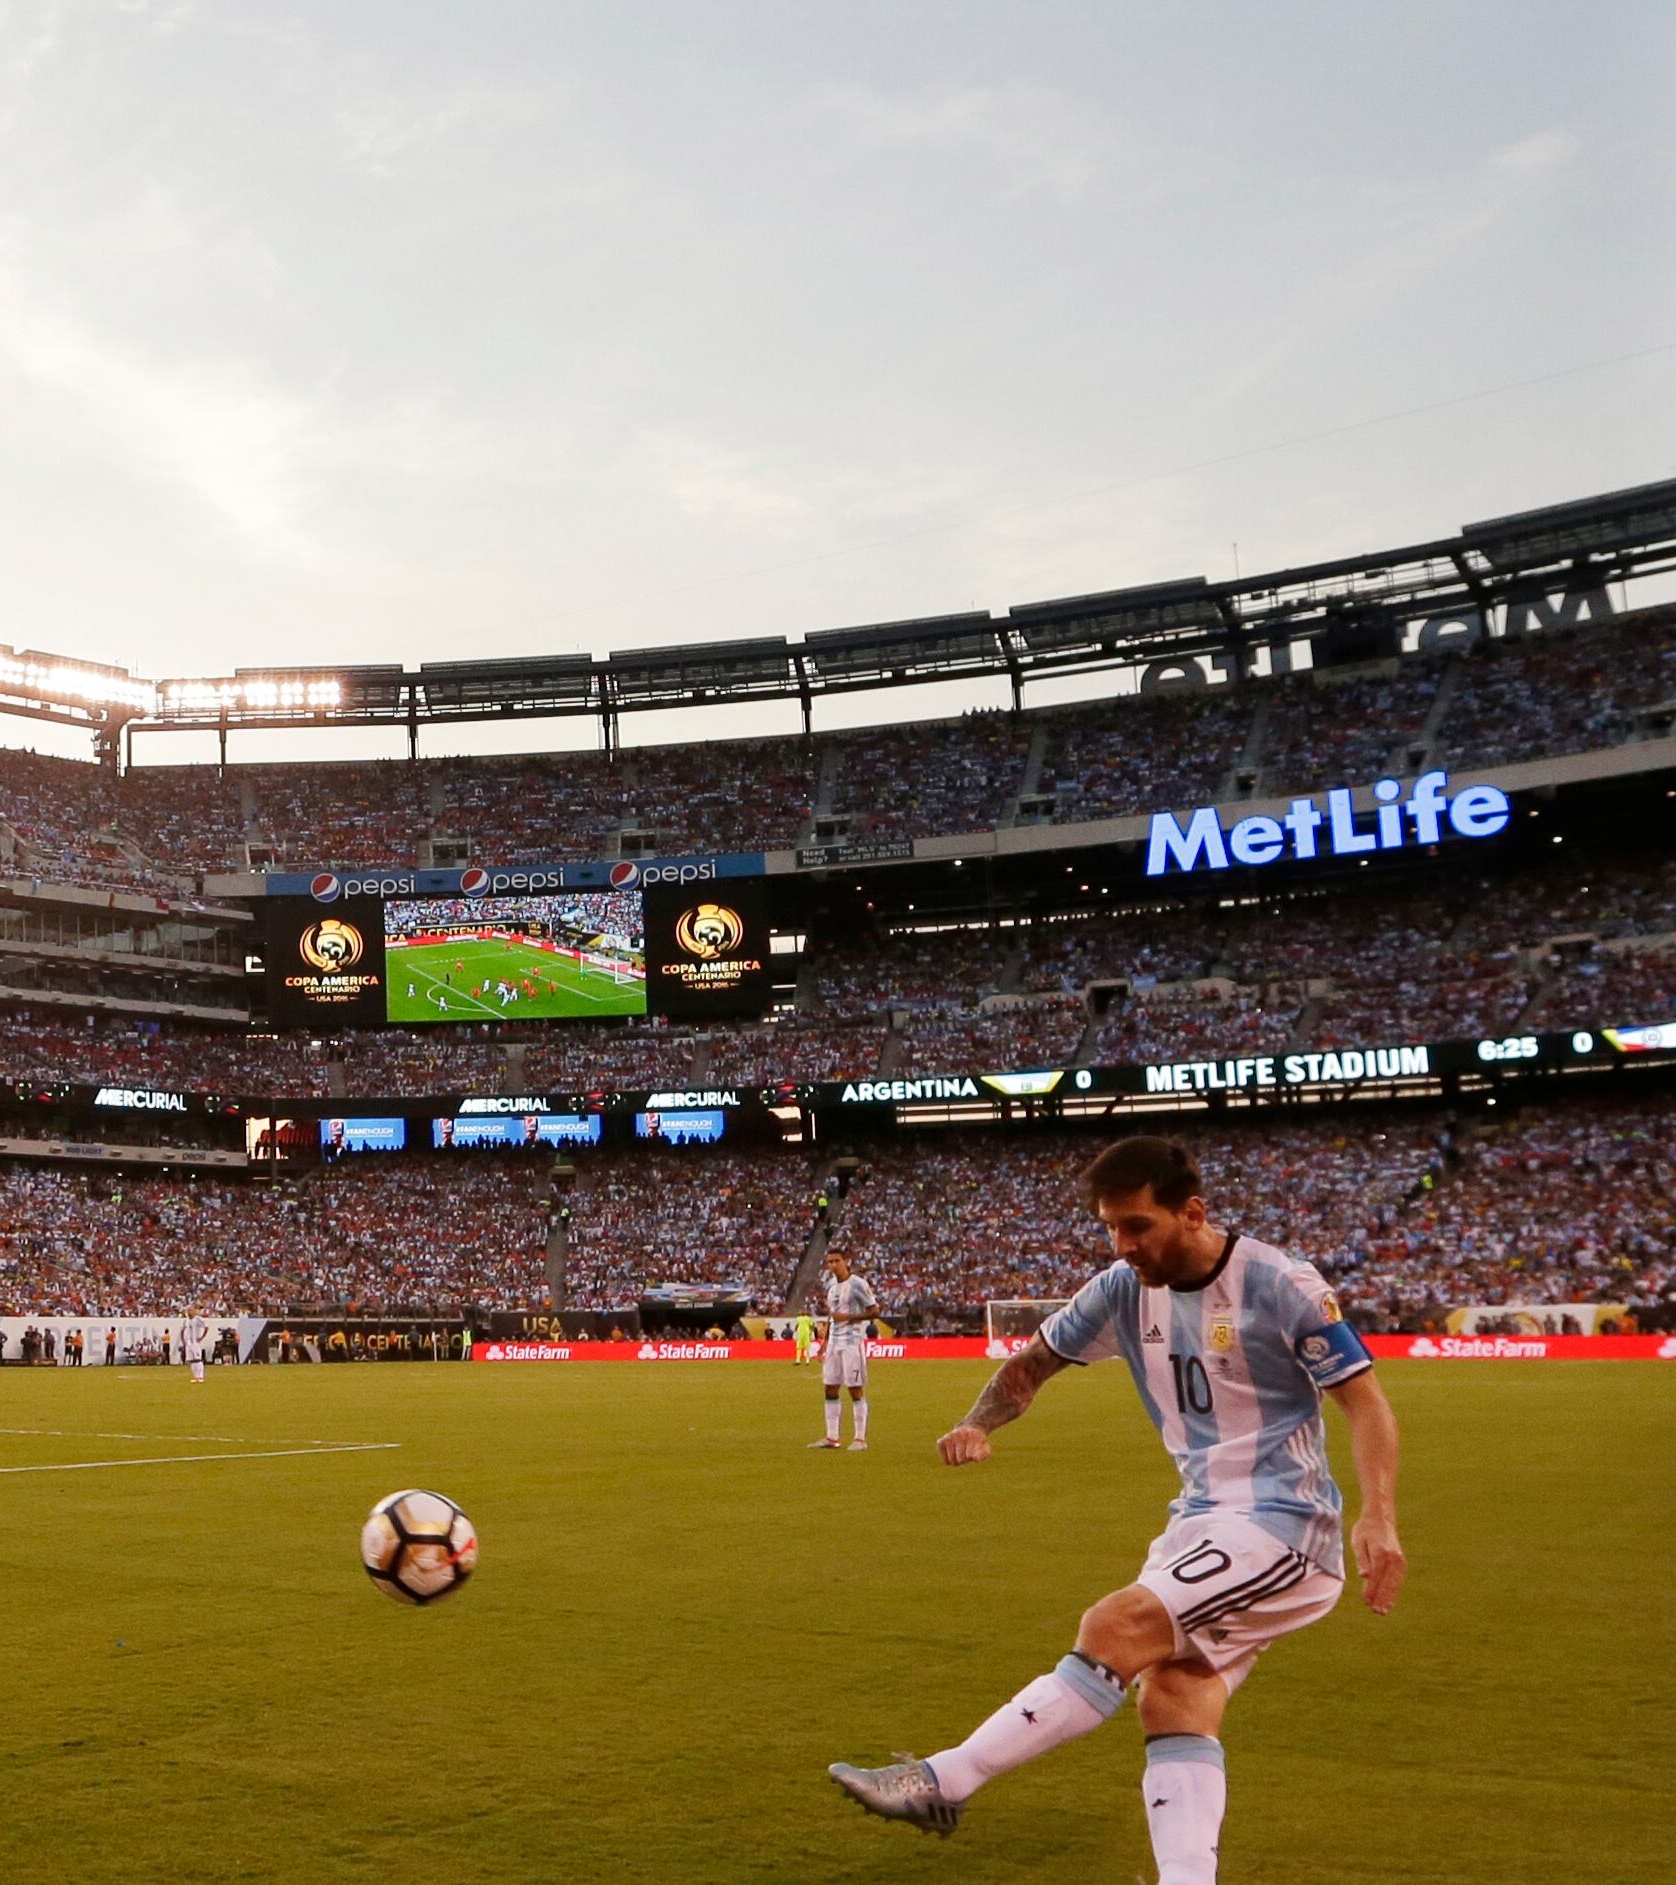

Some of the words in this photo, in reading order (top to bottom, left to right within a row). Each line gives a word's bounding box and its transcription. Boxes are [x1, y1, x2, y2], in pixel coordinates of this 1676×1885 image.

[1146, 769, 1511, 877] MetLife
[803, 848, 826, 857] Need
[803, 856, 828, 865] Help?
[492, 867, 564, 893] pepsi
[643, 859, 716, 888] pepsi
[344, 875, 415, 899] pepsi
[661, 963, 697, 974] COPA
[699, 960, 761, 973] AMERICA
[682, 971, 742, 981] CENTENARIO
[285, 977, 319, 986] COPA
[321, 976, 379, 986] AMERICA
[304, 985, 361, 994] CENTENARIO
[1477, 1036, 1539, 1061] 6:25
[1572, 1031, 1593, 1054] 0
[1075, 1070, 1092, 1089] 0
[1145, 1057, 1277, 1093] METLIFE
[1284, 1046, 1429, 1084] STADIUM
[94, 1088, 188, 1111] MERCURIAL
[645, 1091, 741, 1108] MERCURIAL
[841, 1076, 979, 1103] ARGENTINA
[459, 1097, 551, 1113] MERCURIAL
[852, 1369, 860, 1382] 7
[1168, 1353, 1214, 1415] 10
[1162, 1538, 1232, 1584] 10
